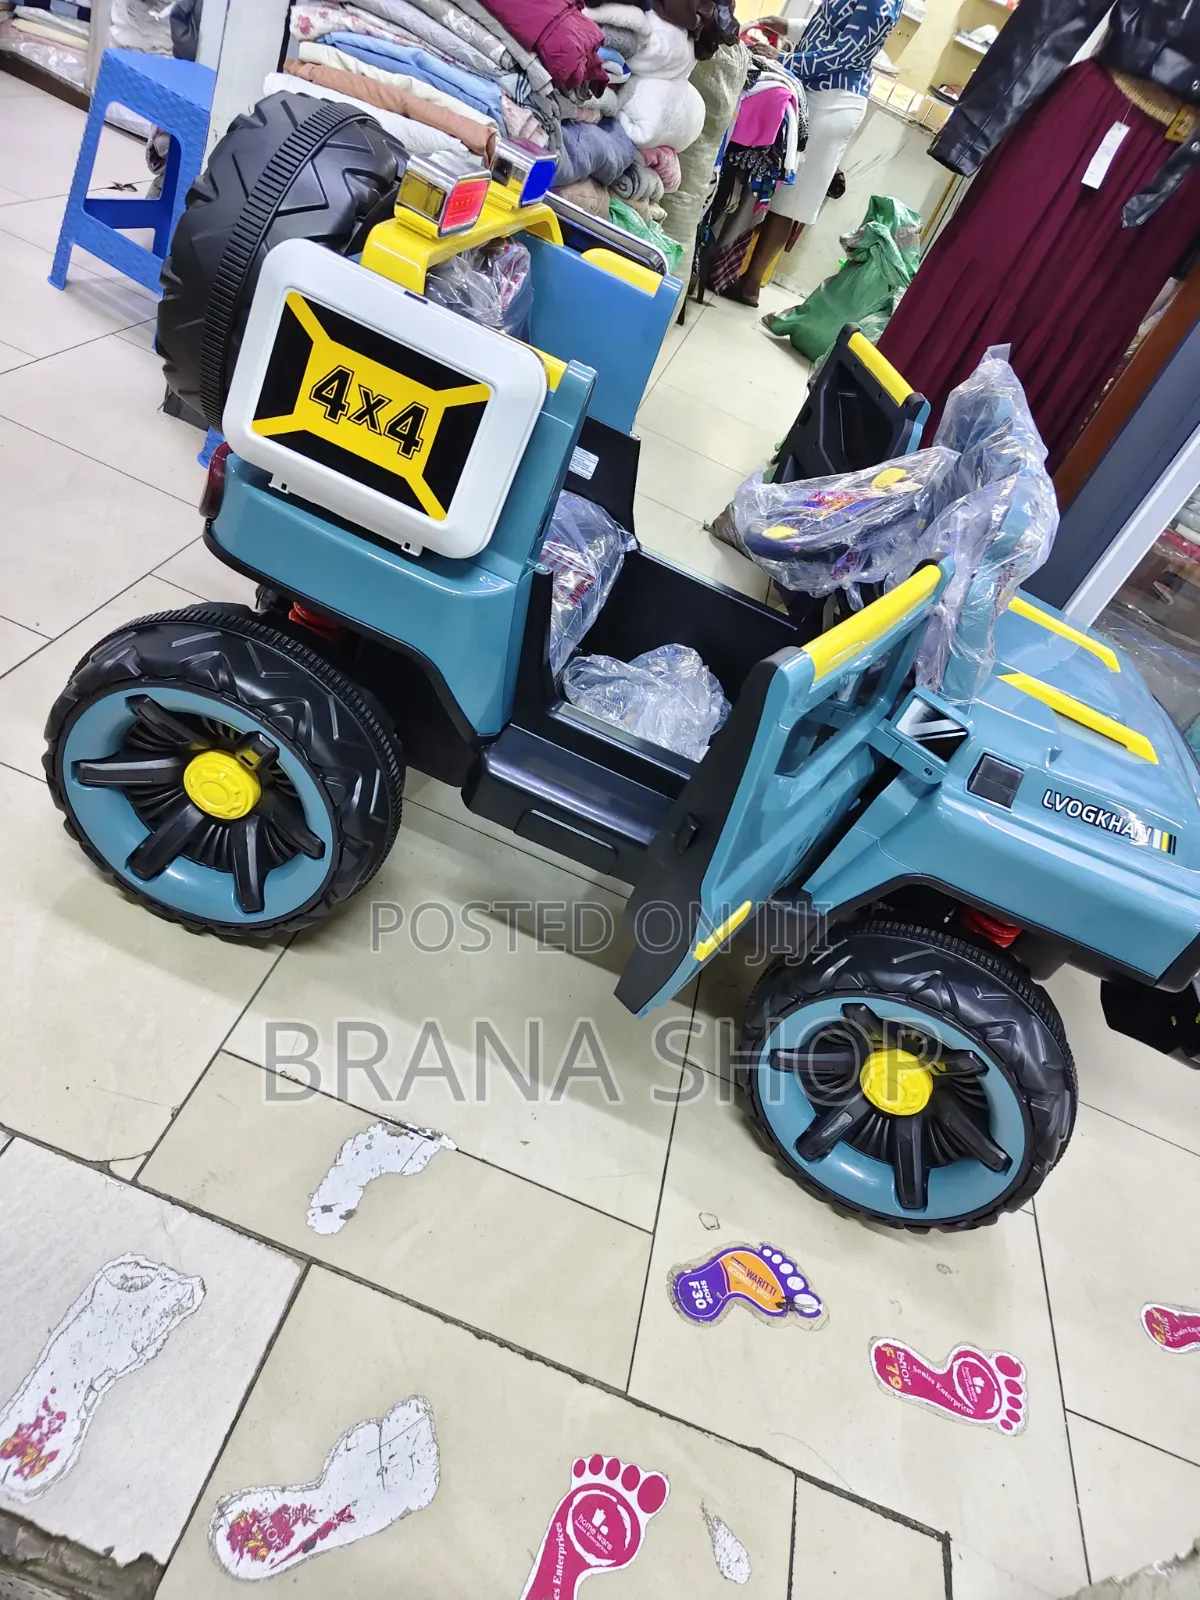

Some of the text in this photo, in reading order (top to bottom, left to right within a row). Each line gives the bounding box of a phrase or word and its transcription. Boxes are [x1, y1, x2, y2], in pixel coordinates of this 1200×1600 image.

[309, 364, 429, 460] 4x4
[689, 1281, 708, 1310] F30
[699, 1279, 714, 1305] SHOP
[746, 1268, 777, 1297] WARITTI
[578, 1514, 613, 1551] home ware
